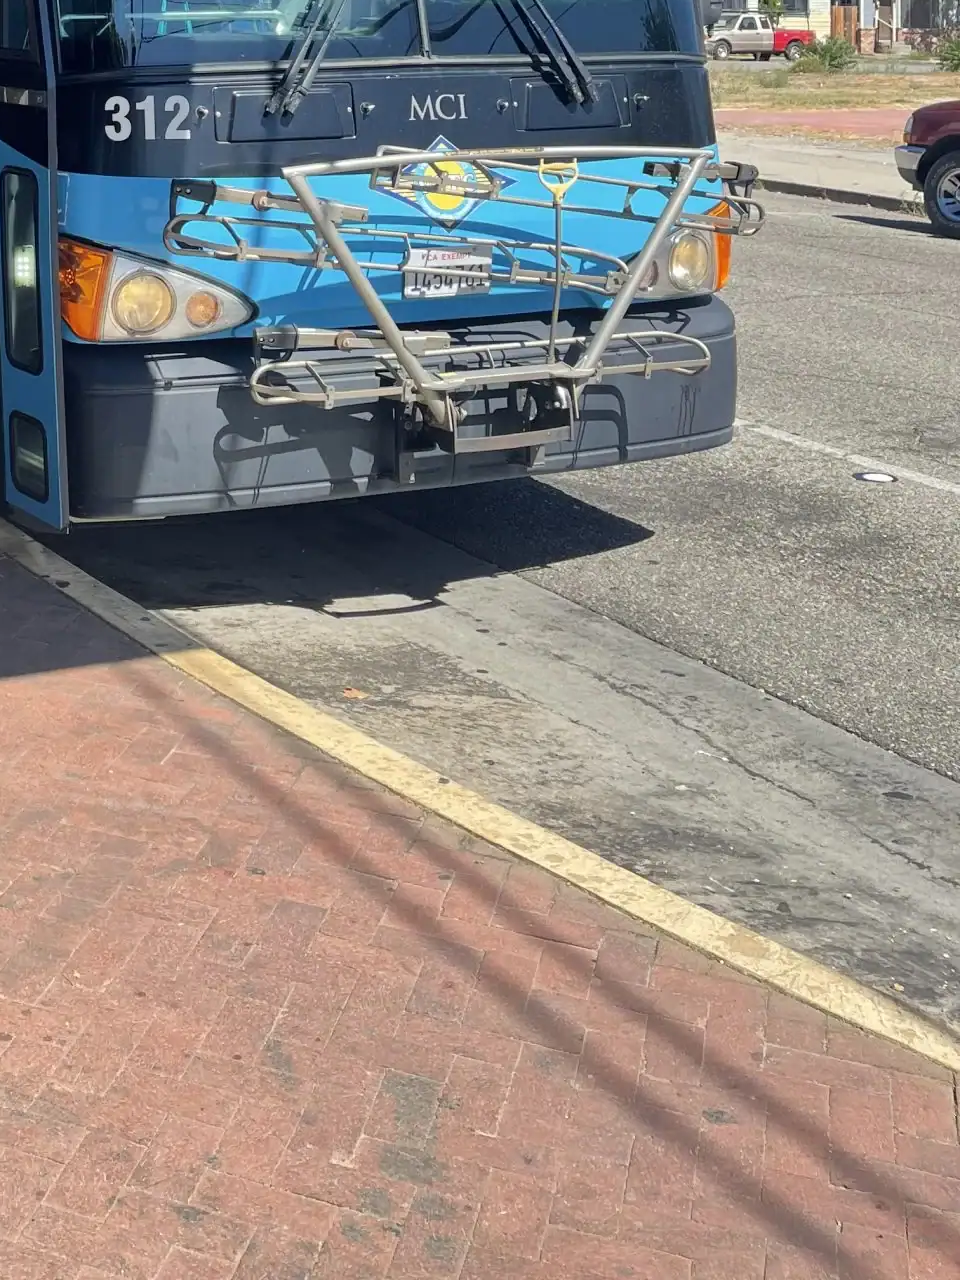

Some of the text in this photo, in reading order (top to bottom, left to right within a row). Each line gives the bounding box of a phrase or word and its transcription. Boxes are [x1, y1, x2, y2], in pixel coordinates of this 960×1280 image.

[104, 94, 191, 142] 312
[408, 94, 468, 120] MCI
[441, 251, 472, 261] EXEMPT
